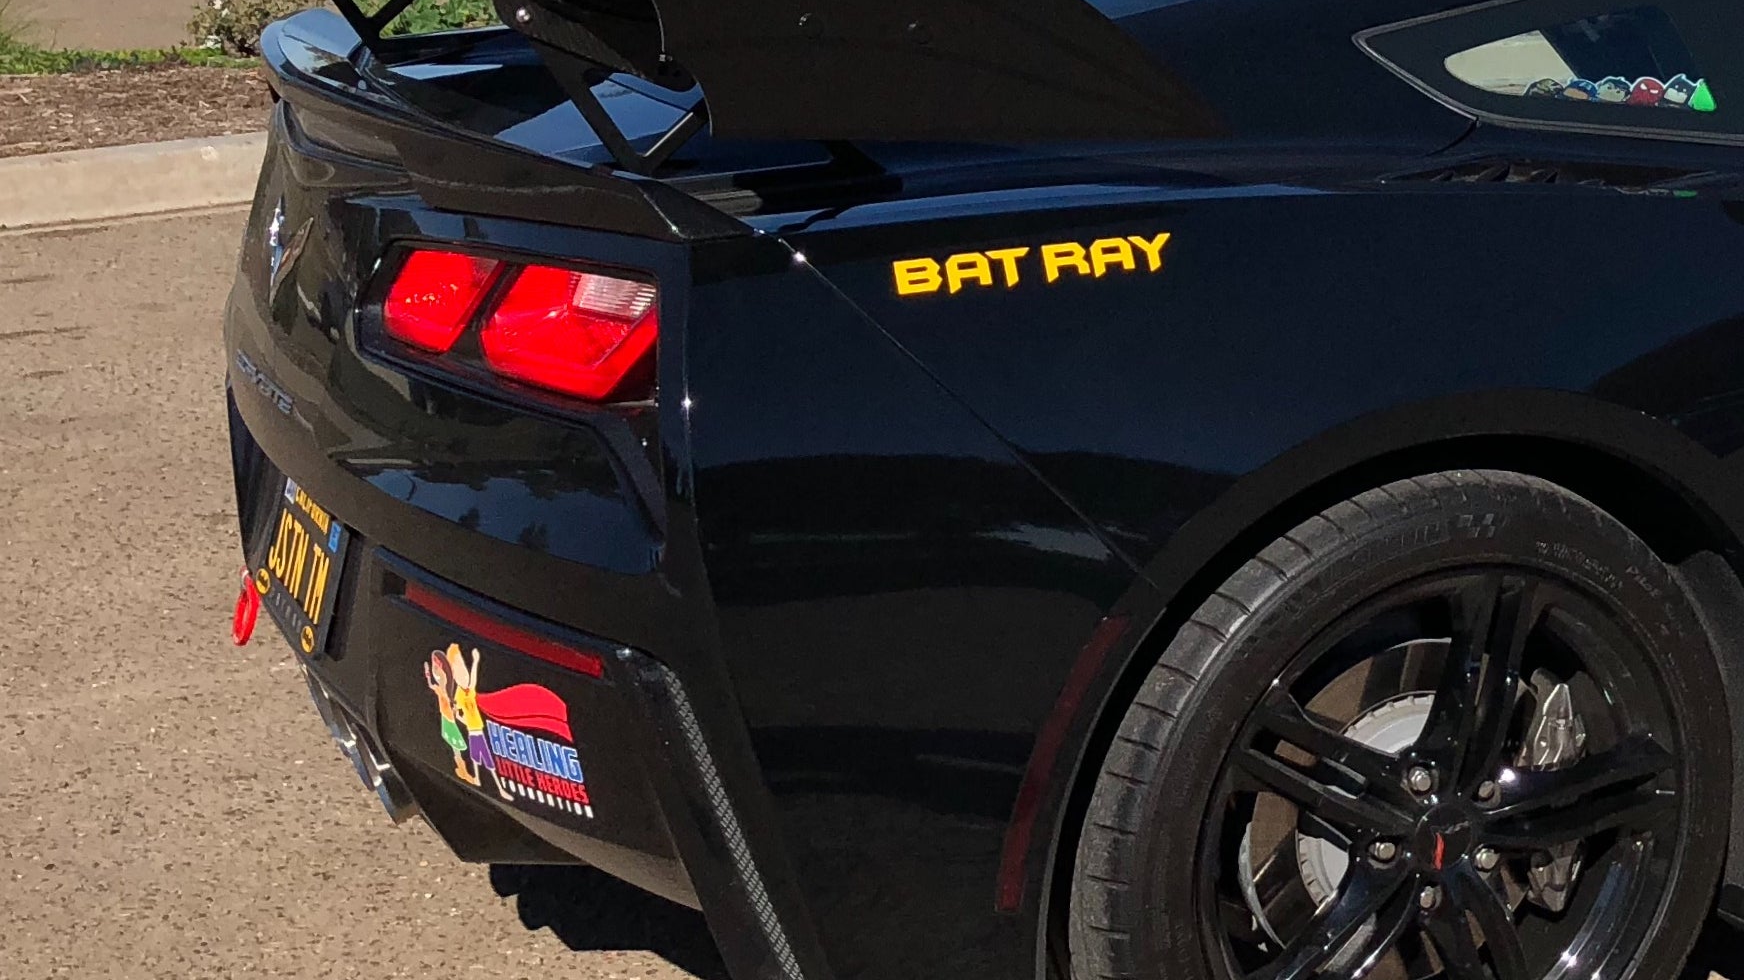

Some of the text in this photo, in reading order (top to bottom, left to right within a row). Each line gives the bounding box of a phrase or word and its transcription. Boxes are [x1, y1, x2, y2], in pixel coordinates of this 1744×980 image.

[893, 232, 1170, 295] BAT RAY
[268, 507, 310, 600] JSTN
[485, 719, 584, 783] HEALING
[495, 756, 590, 805] LITTLE HEROES
